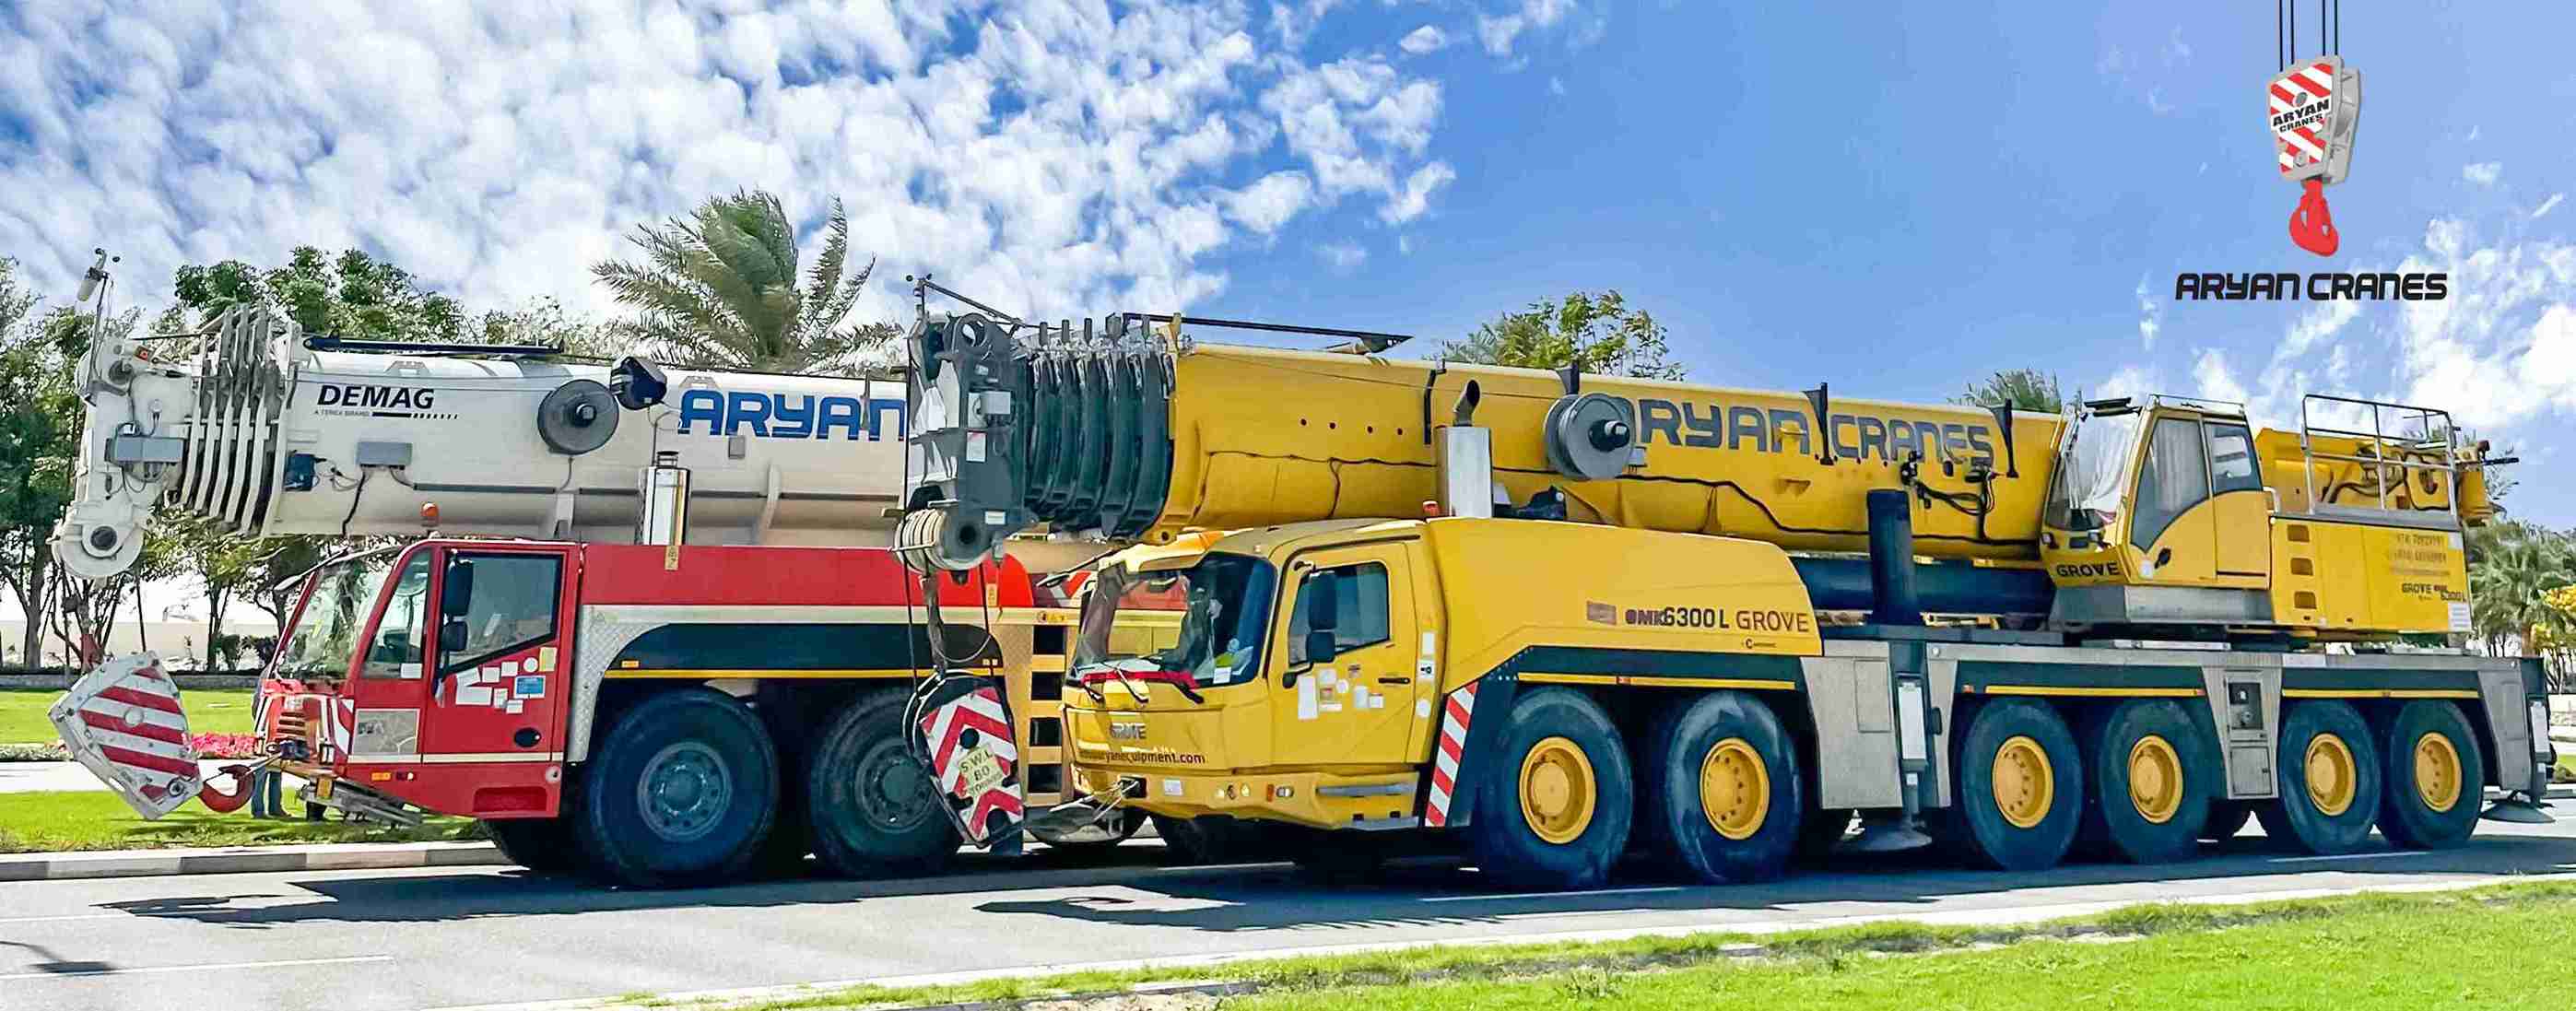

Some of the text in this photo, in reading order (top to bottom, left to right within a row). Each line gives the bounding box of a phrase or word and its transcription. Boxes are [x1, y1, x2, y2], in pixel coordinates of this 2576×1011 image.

[317, 384, 434, 409] DEMAG
[677, 389, 906, 441] ARYAN
[1831, 414, 1994, 466] CRANES
[2056, 561, 2120, 577] GROVE
[1736, 609, 1809, 633] GROVE
